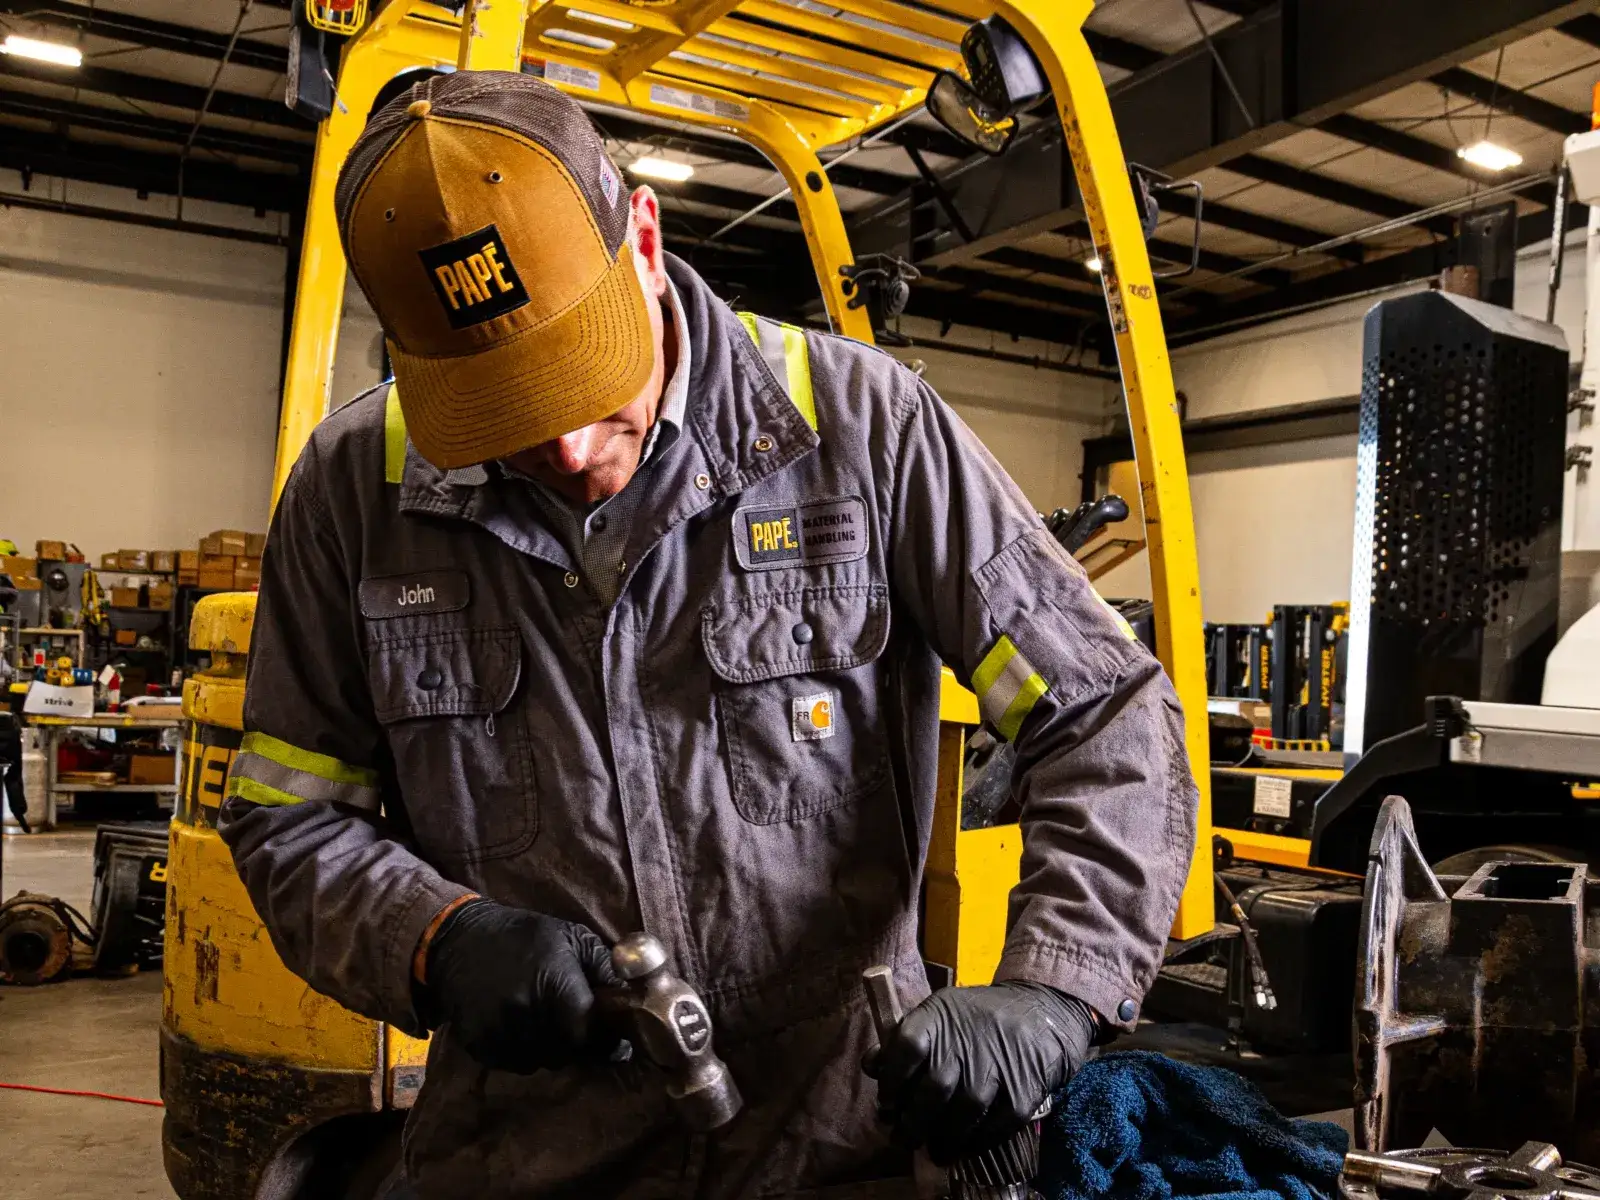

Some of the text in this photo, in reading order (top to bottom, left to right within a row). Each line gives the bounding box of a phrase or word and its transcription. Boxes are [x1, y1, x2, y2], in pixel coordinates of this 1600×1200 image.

[802, 513, 854, 528] MATERIAL
[804, 530, 856, 546] HANDLING
[397, 583, 435, 606] John
[1260, 645, 1269, 689] HYSTER
[1321, 649, 1331, 707] HYSTER
[796, 711, 810, 720] FR
